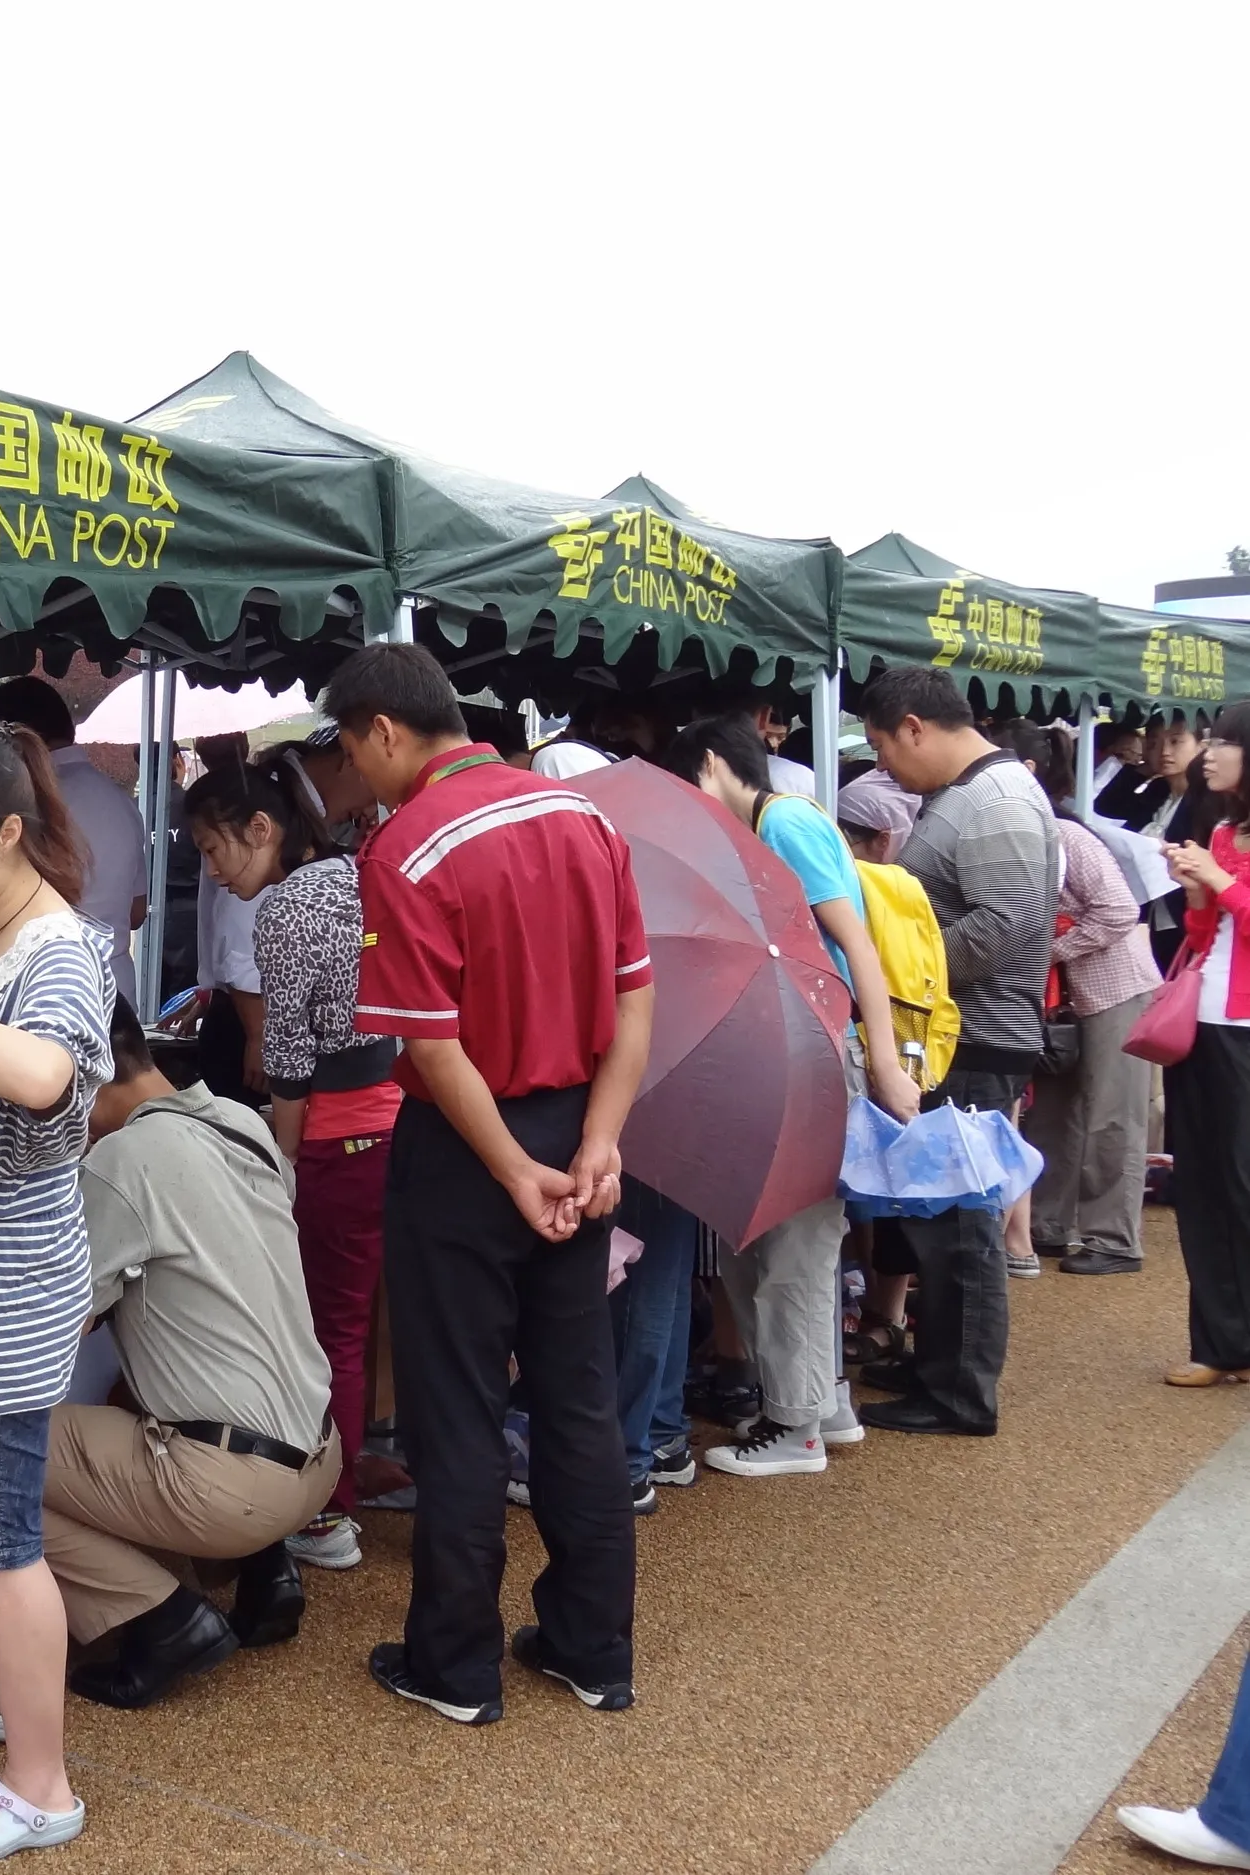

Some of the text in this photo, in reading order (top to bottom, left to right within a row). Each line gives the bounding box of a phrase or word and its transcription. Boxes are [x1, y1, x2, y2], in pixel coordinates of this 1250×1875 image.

[72, 510, 175, 569] POST
[612, 506, 737, 590] 中国邮政
[613, 565, 732, 626] CHINA POST
[966, 594, 1043, 650] 中国邮政
[971, 643, 1044, 676] CHINA POST
[1169, 632, 1224, 676] 中国邮政
